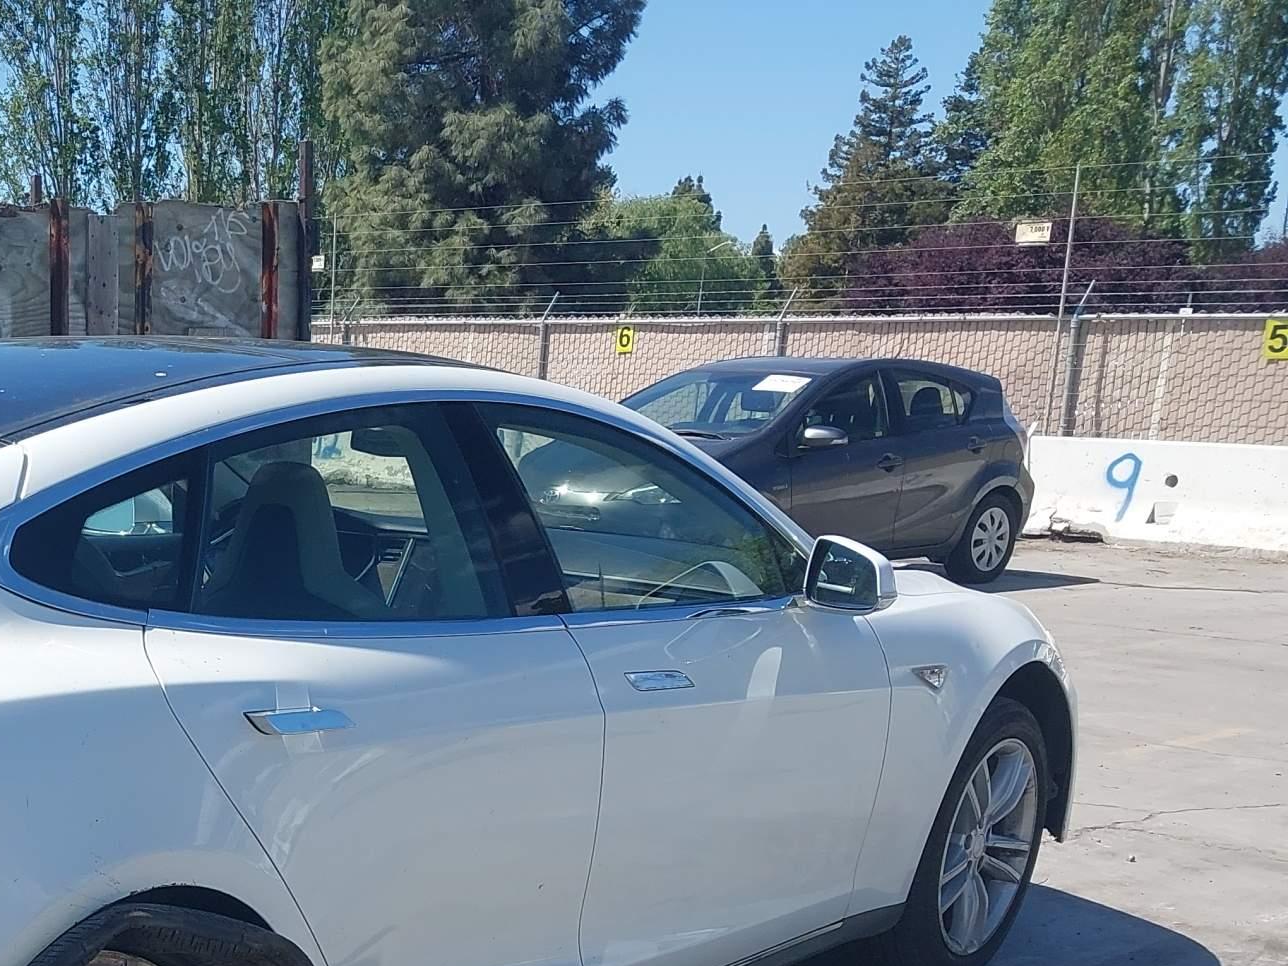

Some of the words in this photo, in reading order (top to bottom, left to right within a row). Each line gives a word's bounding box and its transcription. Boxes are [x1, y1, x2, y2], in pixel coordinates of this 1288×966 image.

[619, 326, 631, 348] 6
[1268, 324, 1288, 353] 5
[1106, 452, 1143, 523] 9
